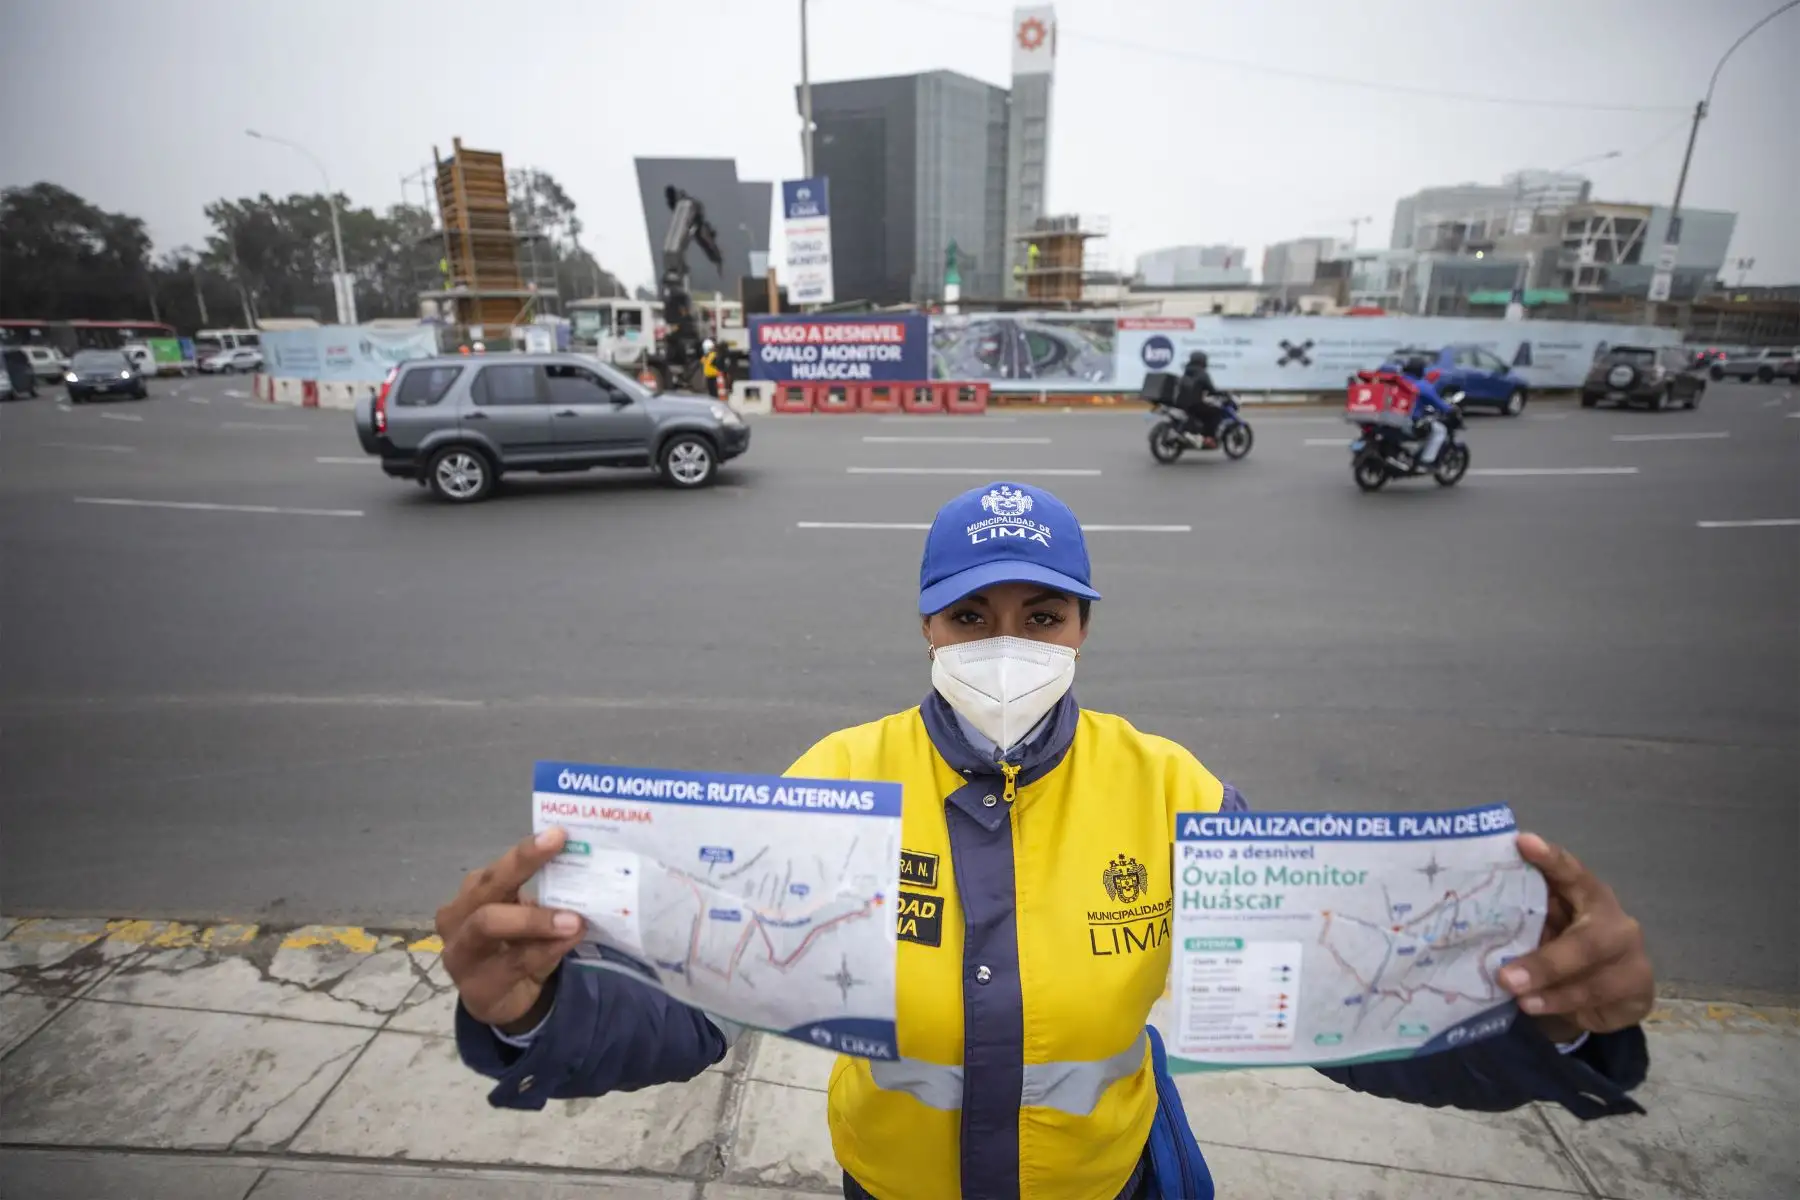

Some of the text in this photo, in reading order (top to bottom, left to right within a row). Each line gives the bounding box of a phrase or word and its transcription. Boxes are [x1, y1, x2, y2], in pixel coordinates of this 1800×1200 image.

[762, 324, 902, 343] PASO A DESNIVEL
[760, 342, 902, 362] ÓVALO MONITOR
[791, 361, 872, 379] HUÁSCAR
[967, 516, 1051, 535] MUNICIPALIDAD DE
[971, 527, 1050, 547] LIMA
[558, 769, 875, 811] ÓVALO MONITOR: RUTAS ALTERNAS
[541, 800, 654, 823] HACIA LA MOLINA
[1183, 814, 1352, 837] ACTUALIZACIÓN
[1356, 818, 1396, 836] DEL
[1398, 816, 1453, 836] PLAN
[1454, 813, 1478, 833] DE
[1183, 845, 1315, 860] Paso a desnivel
[1182, 860, 1368, 887] Óvalo Monitor
[1182, 888, 1285, 911] Huáscar
[1087, 902, 1164, 920] MUNICIPALIDAD
[1089, 917, 1170, 956] LIMA
